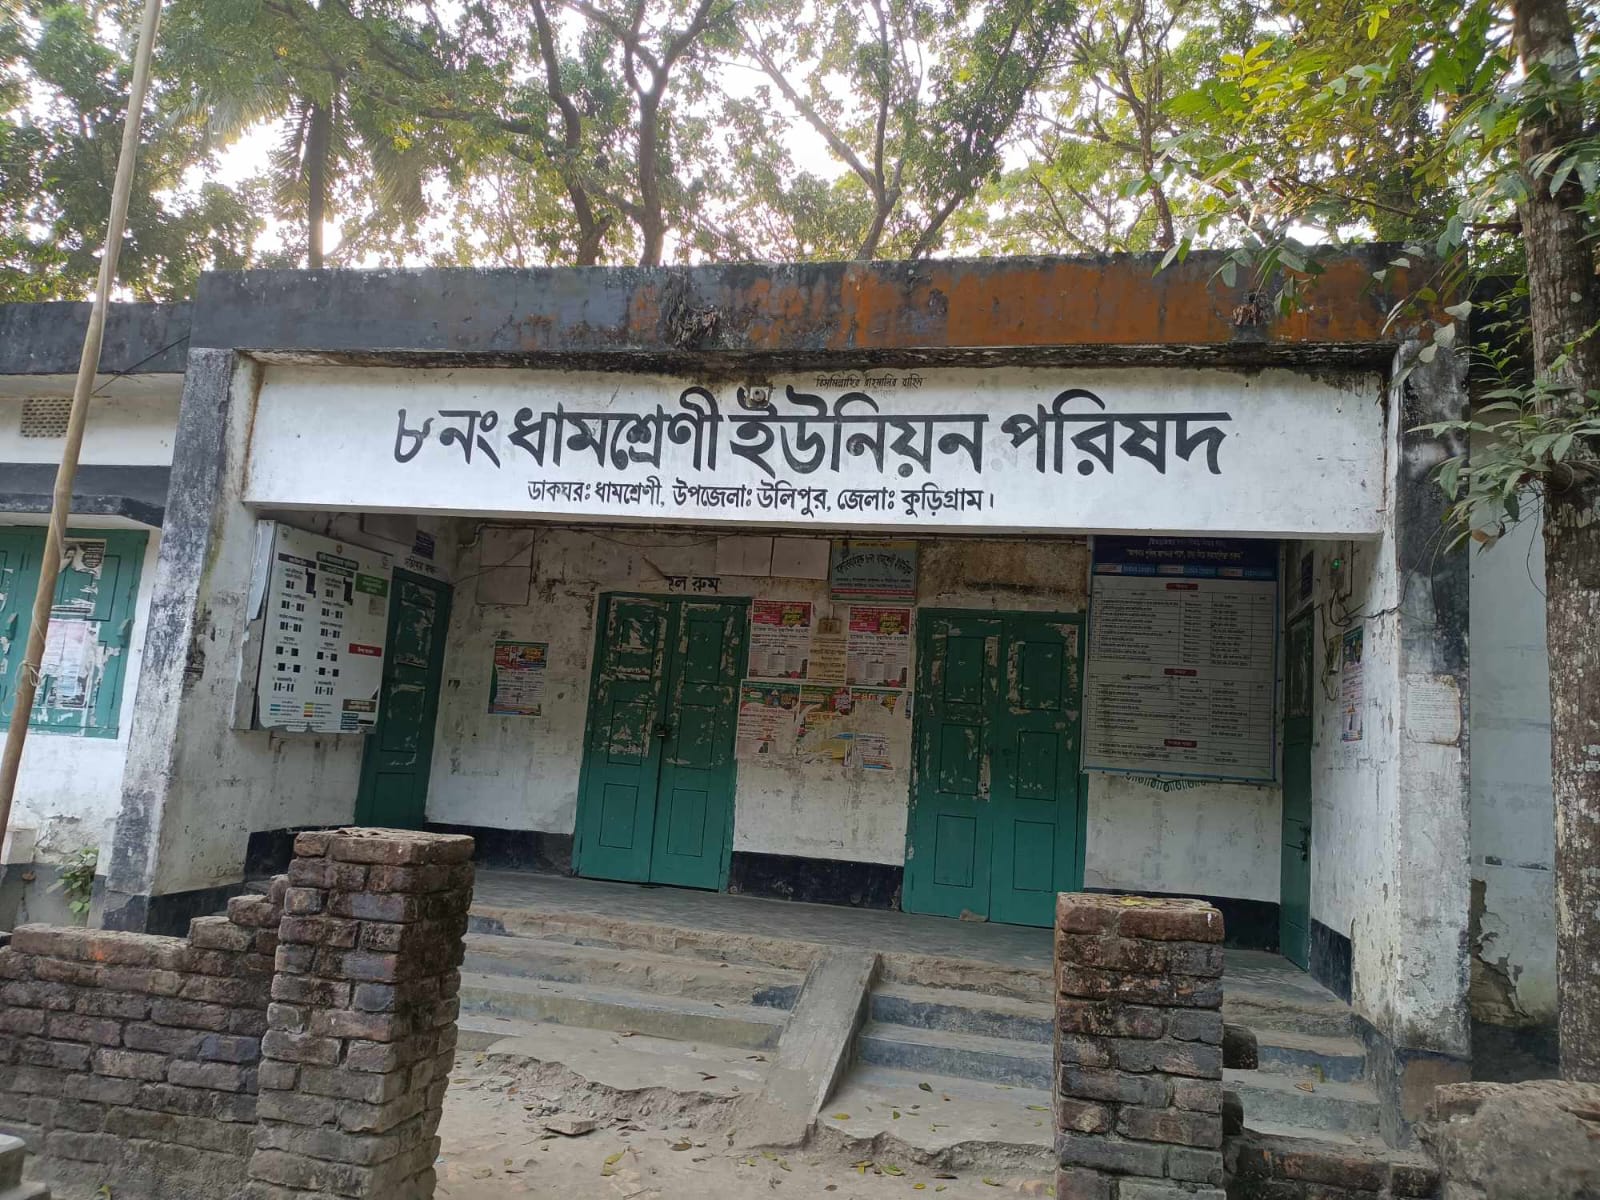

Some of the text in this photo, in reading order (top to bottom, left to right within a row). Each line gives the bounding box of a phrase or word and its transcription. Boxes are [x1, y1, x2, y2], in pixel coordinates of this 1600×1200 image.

[508, 386, 723, 472] ধামশ্রেণী
[728, 384, 989, 478] ইউনিয়ন
[1000, 388, 1232, 476] পরিষদ
[594, 475, 665, 508] ধামশ্রেণী,
[756, 478, 831, 518] উলিপুর,
